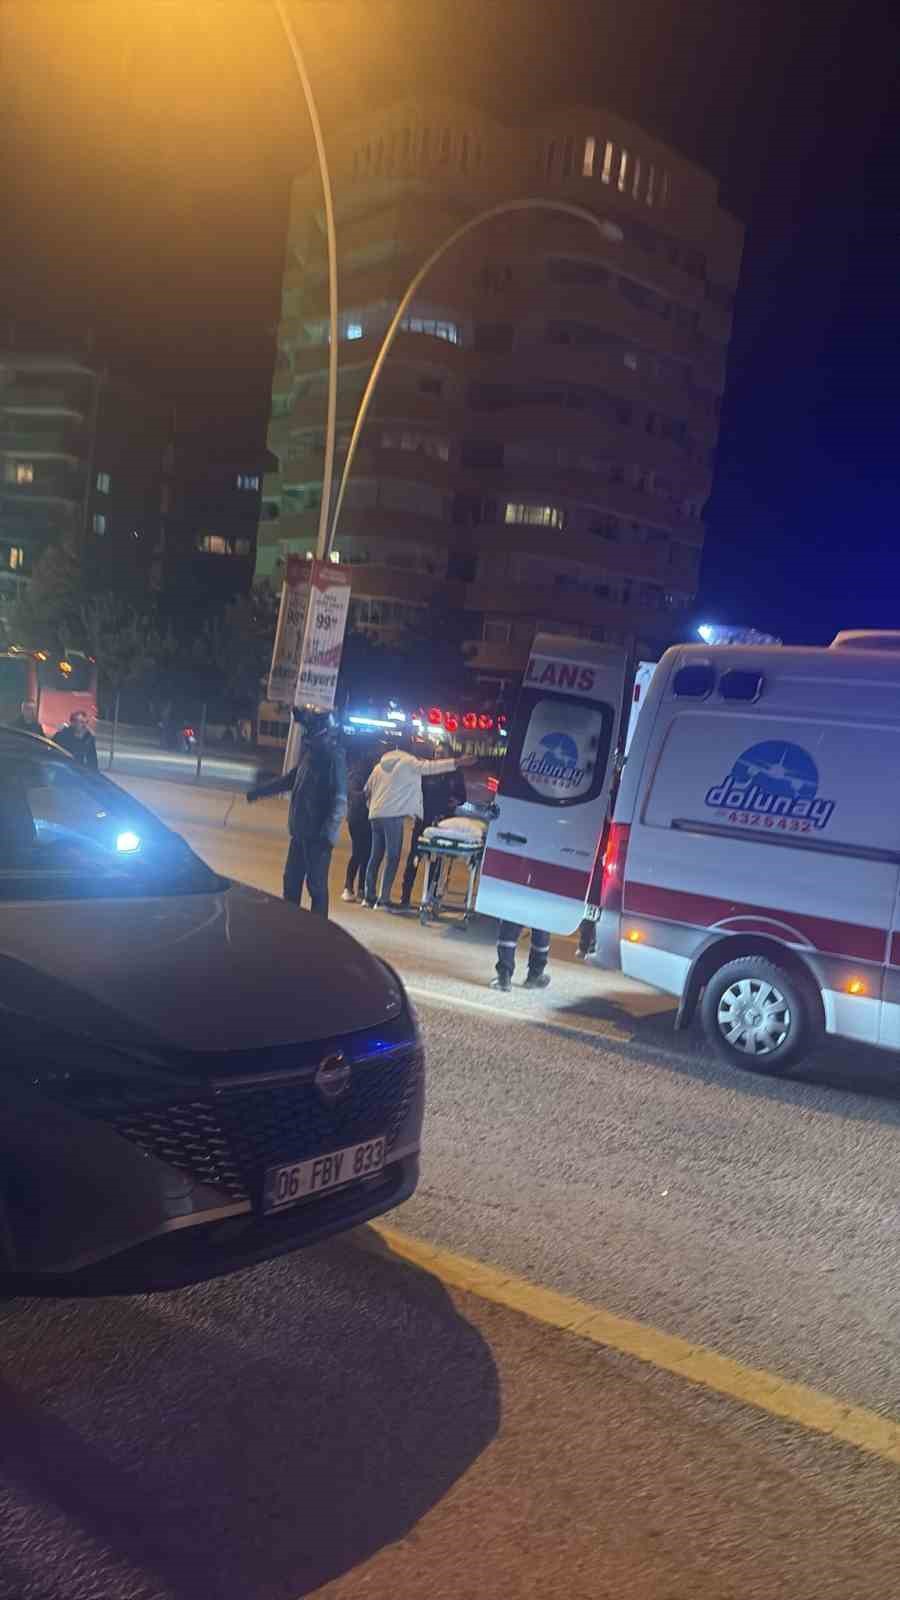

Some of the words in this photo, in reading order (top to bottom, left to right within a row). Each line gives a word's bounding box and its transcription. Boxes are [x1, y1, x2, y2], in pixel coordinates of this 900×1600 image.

[525, 659, 595, 691] LANS
[705, 775, 834, 829] dolunay
[278, 1168, 300, 1199] 06
[353, 1139, 384, 1174] 833
